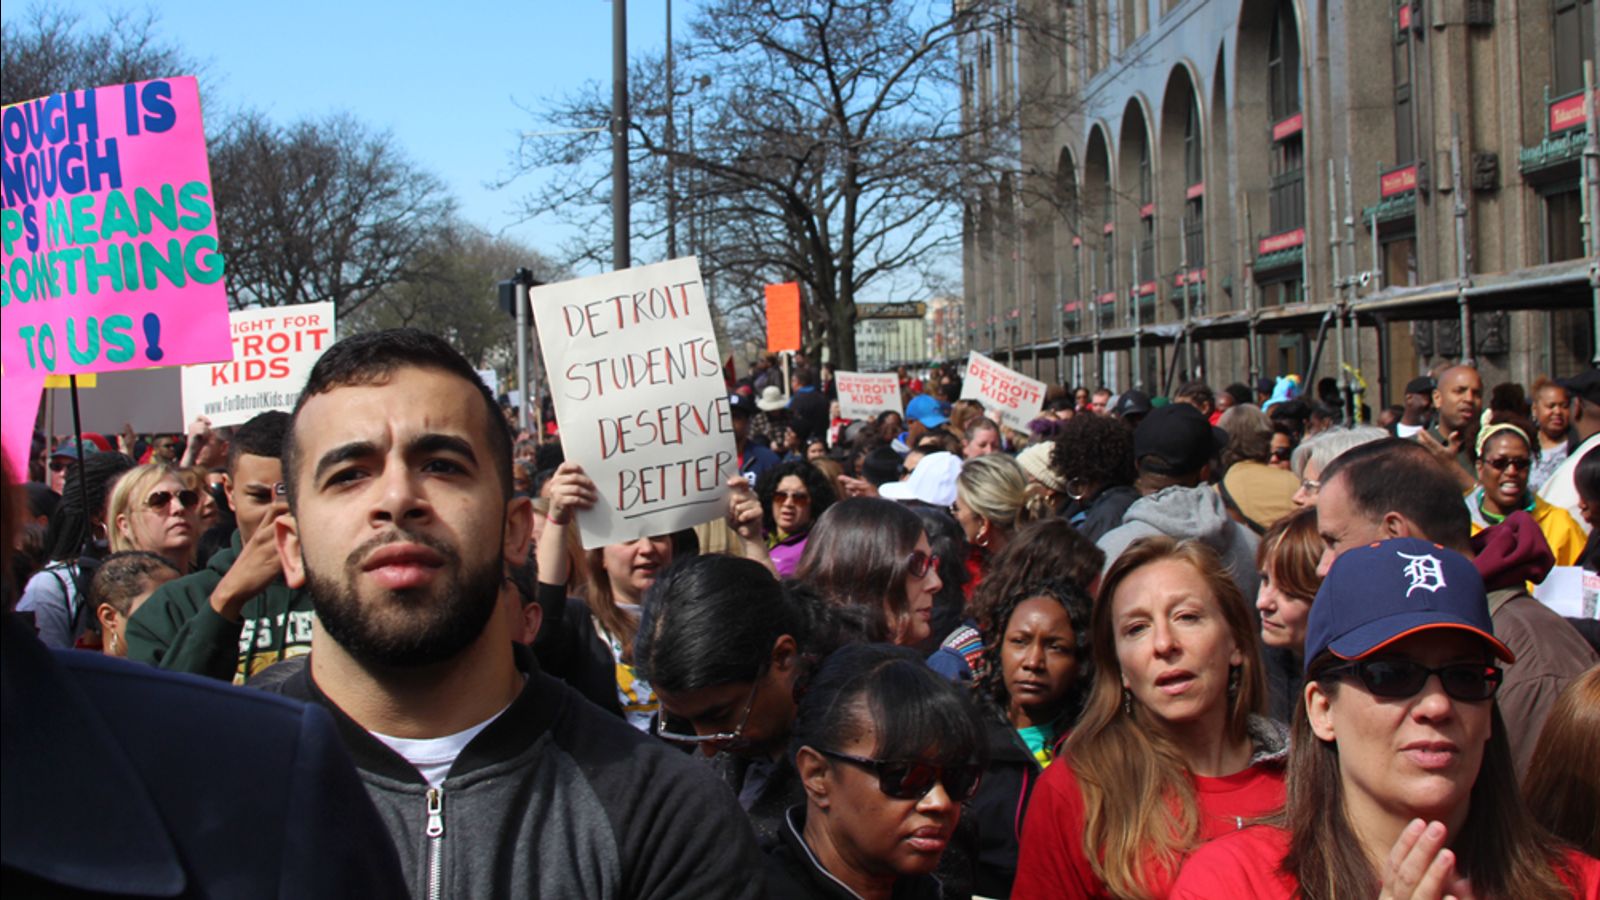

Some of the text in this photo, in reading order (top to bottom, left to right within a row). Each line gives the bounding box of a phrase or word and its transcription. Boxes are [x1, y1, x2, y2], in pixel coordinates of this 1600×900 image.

[1, 80, 177, 157] OUGH IS
[1, 137, 122, 209] NOUGH
[45, 180, 212, 247] MEANS
[230, 314, 321, 334] IGHT FOR
[563, 280, 699, 338] DETROIT
[18, 323, 57, 372] TO
[211, 357, 290, 387] KIDS
[566, 339, 718, 401] STUDENTS
[838, 382, 896, 395] DETROIT
[851, 394, 884, 406] KIDS
[969, 364, 1041, 404] DETROIT
[980, 383, 1020, 409] KIDS
[599, 396, 734, 460] DESERVE
[617, 451, 733, 511] BETTER
[1396, 551, 1447, 598] D
